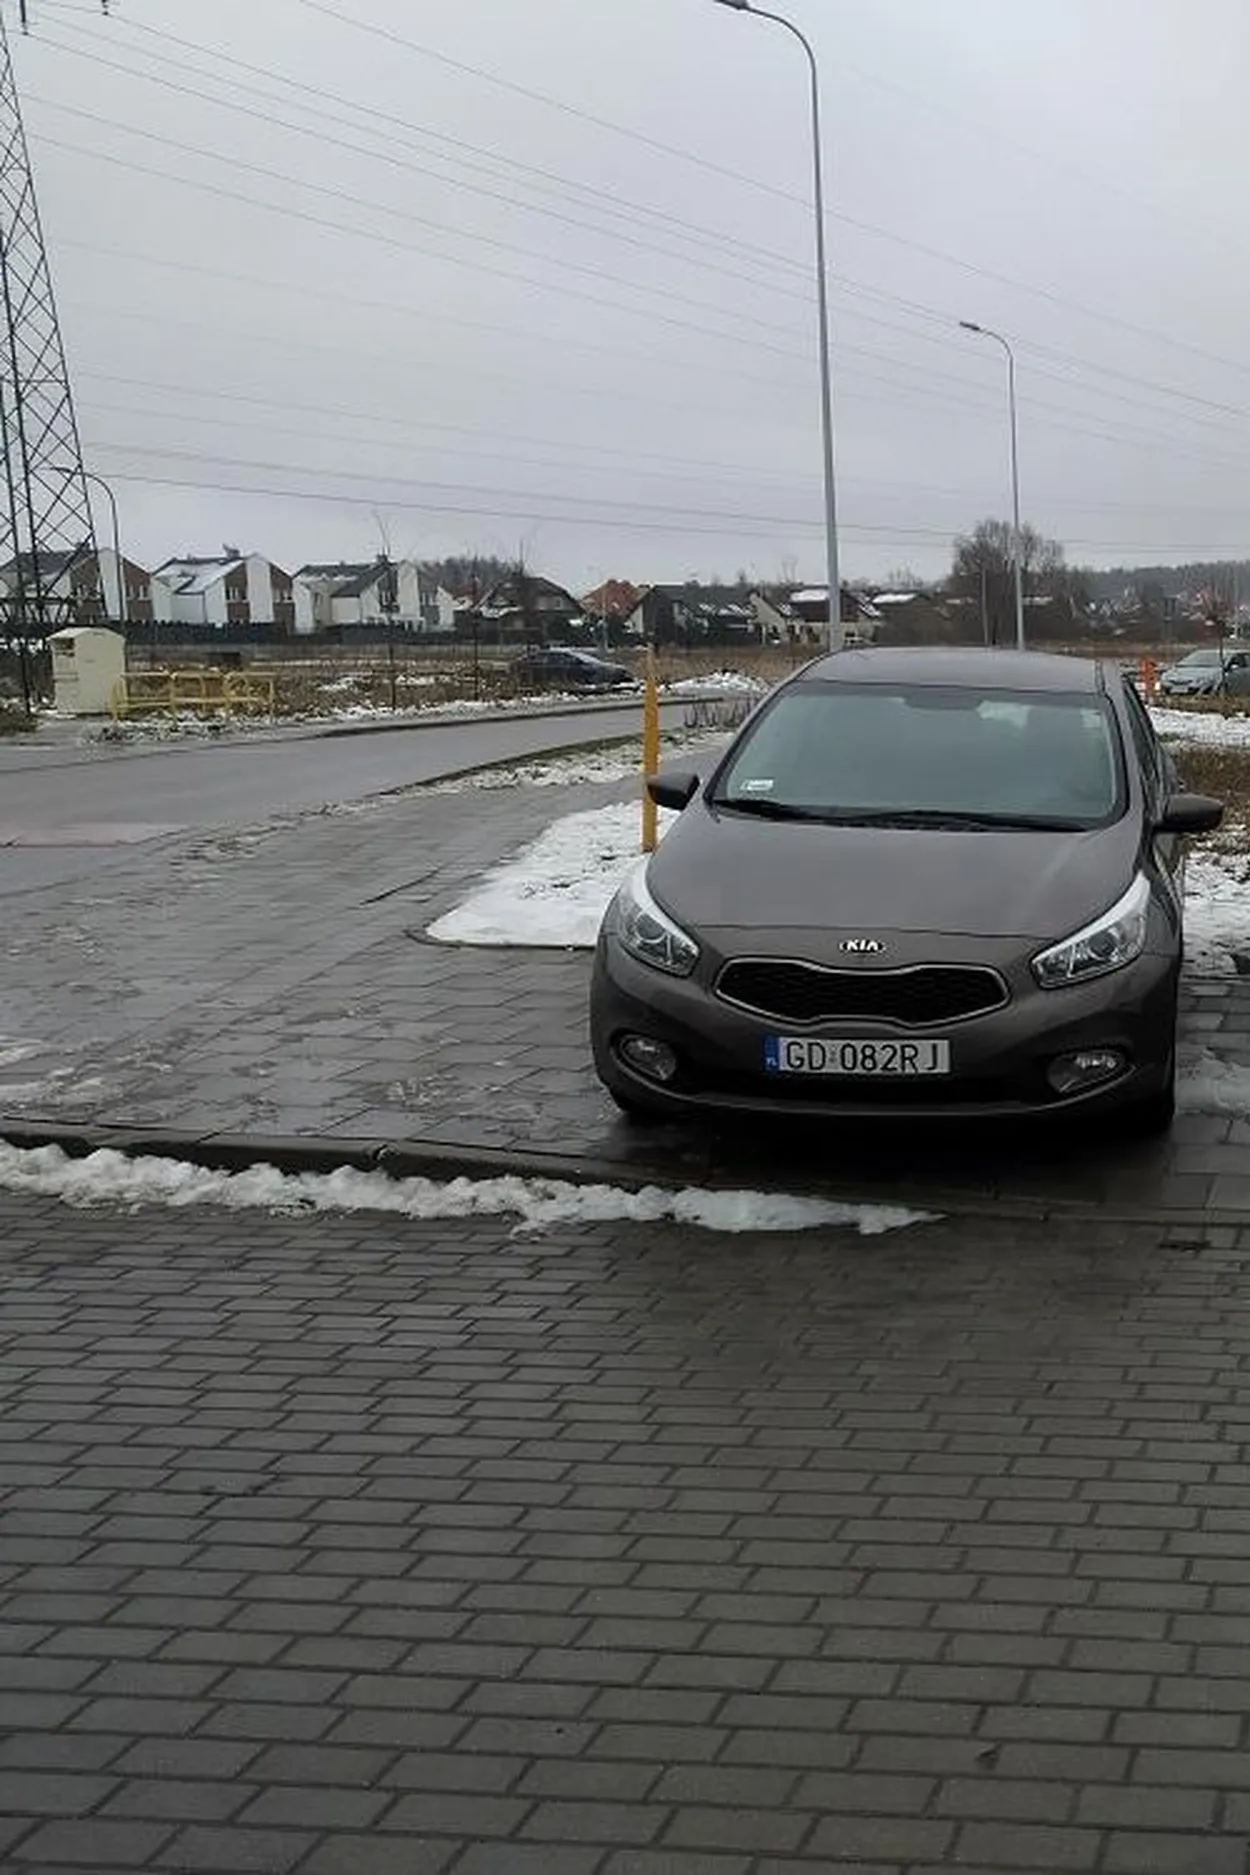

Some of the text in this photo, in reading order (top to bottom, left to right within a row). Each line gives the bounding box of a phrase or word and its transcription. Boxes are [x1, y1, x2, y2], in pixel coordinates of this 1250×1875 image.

[847, 939, 878, 951] KIA
[786, 1041, 938, 1072] GD 082RJ
